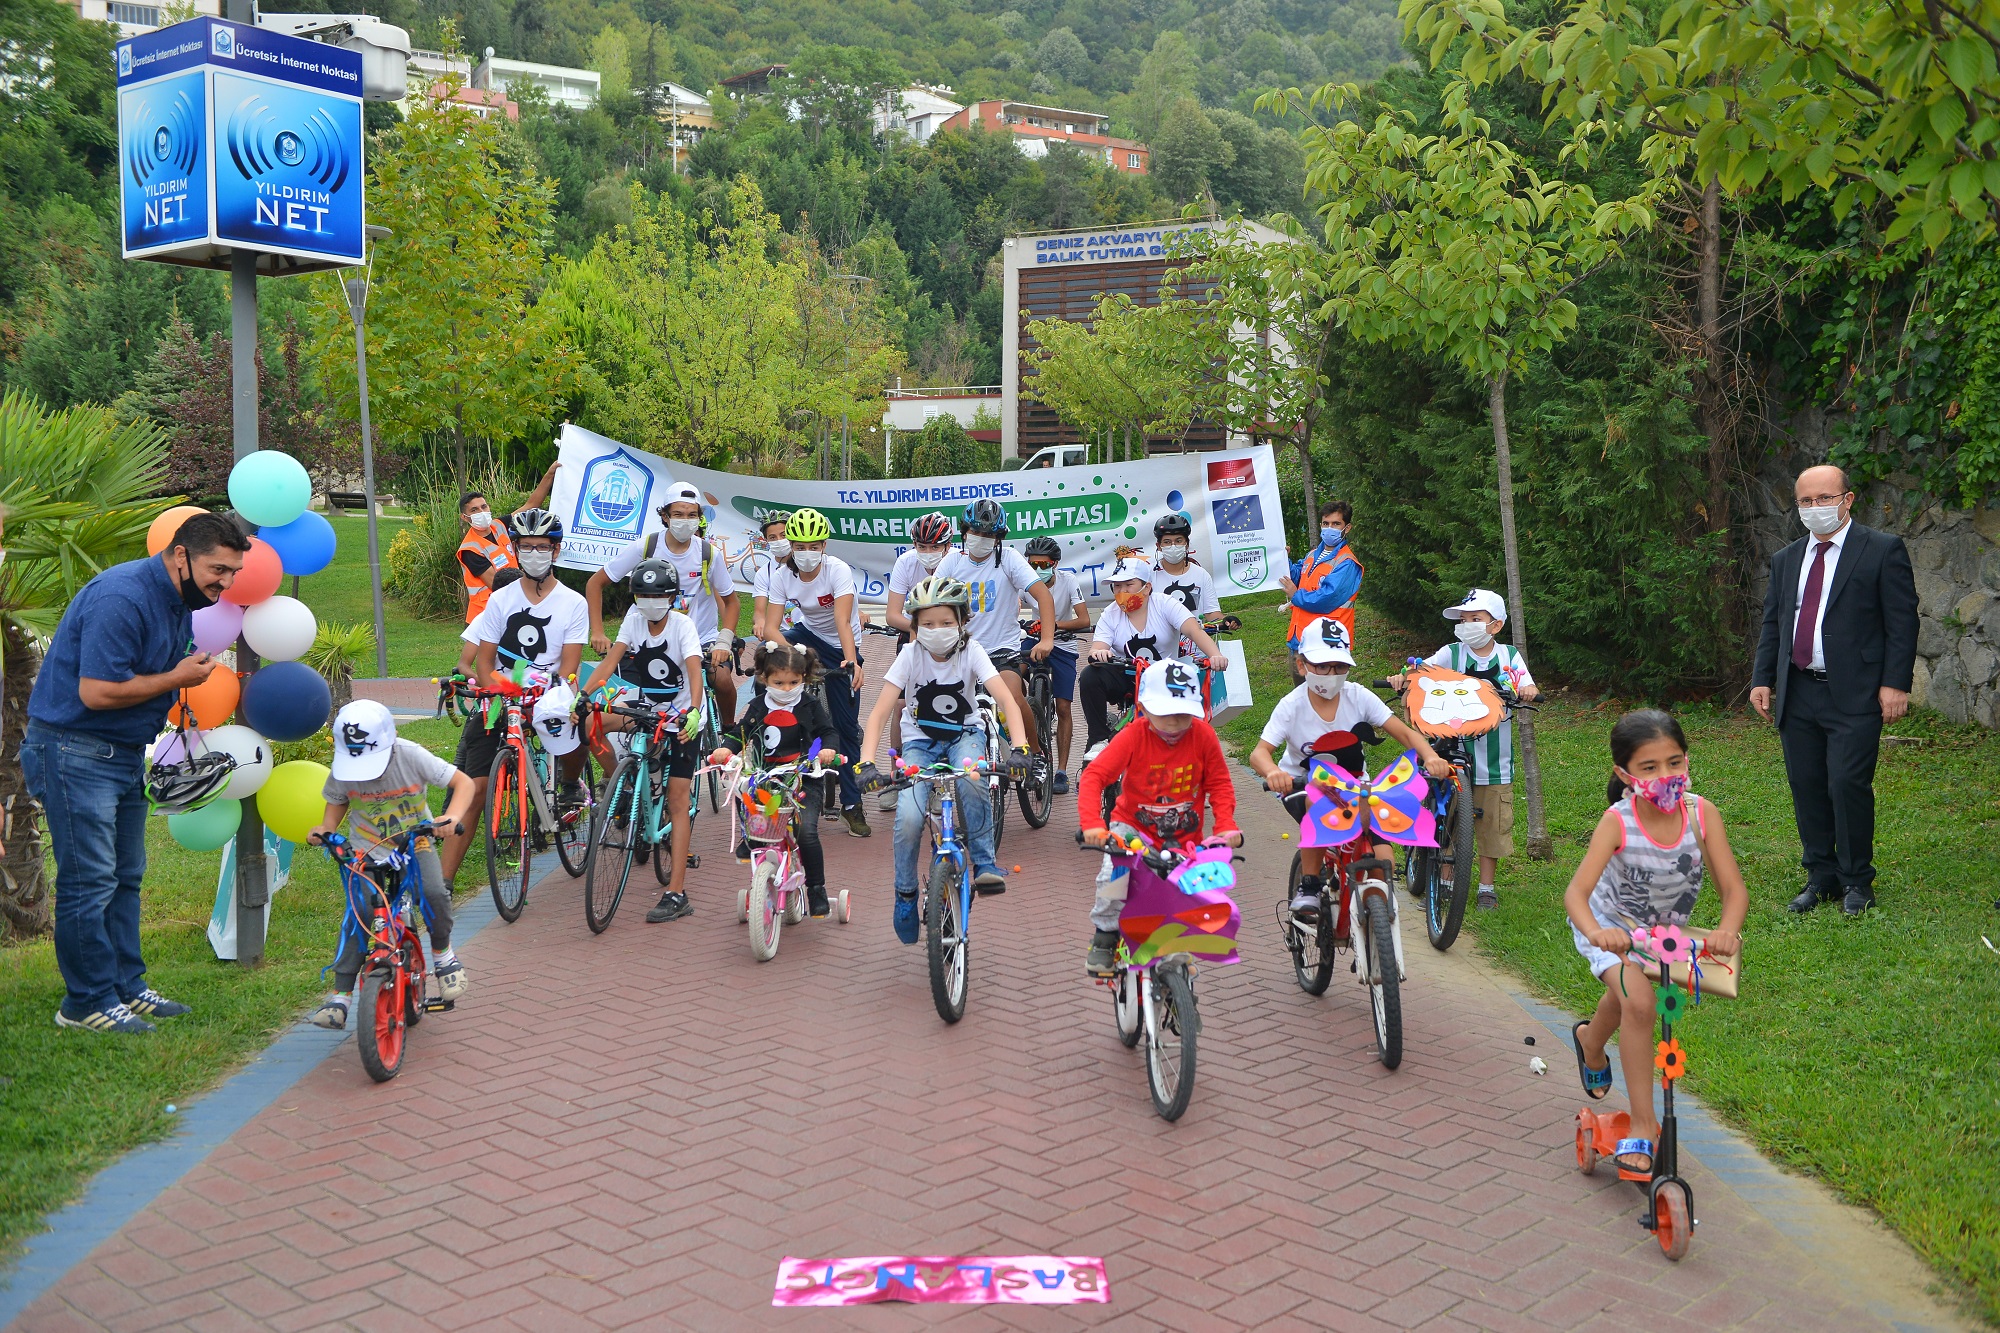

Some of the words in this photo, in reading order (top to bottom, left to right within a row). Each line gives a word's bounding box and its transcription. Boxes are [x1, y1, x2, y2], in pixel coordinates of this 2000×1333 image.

[132, 53, 156, 68] Ücretsiz
[156, 46, 180, 61] İnternet
[180, 40, 203, 55] Noktası
[236, 43, 278, 63] Ücretsiz
[280, 53, 319, 74] İnternet
[321, 62, 358, 82] Noktası
[144, 177, 187, 198] YILDIRIM
[255, 180, 330, 205] YILDIRIM
[144, 194, 188, 228] NET
[255, 197, 329, 233] NET
[1036, 251, 1084, 263] BALIK
[1090, 247, 1146, 260] TUTMA
[837, 491, 862, 504] T.C.
[864, 488, 928, 503] YILDIRIM
[1016, 503, 1111, 532] HAFTASI
[573, 526, 602, 536] YILDIRIM
[560, 541, 599, 554] OKTAY
[1233, 556, 1261, 565] BİSİKLET
